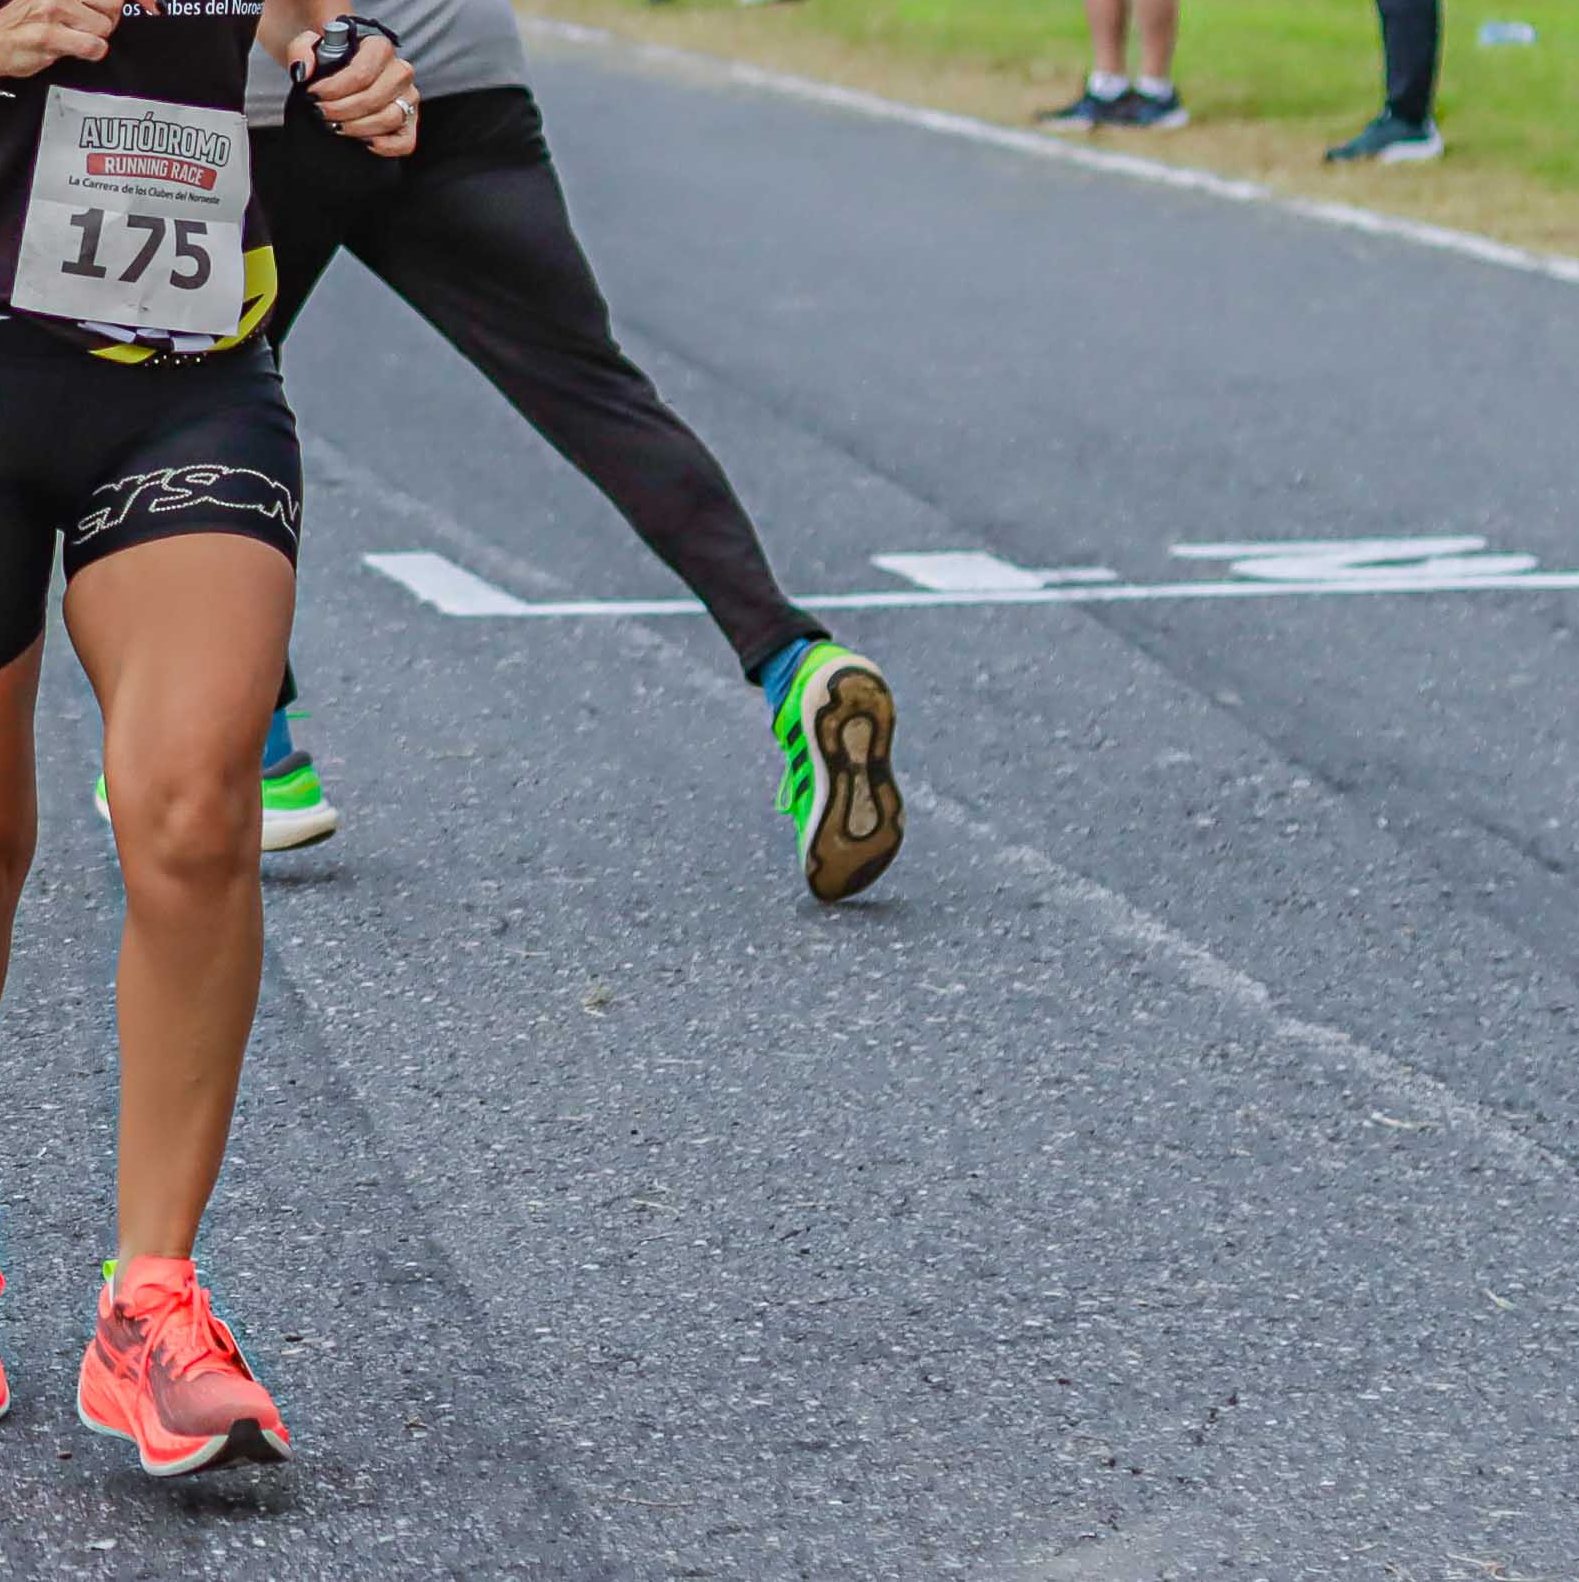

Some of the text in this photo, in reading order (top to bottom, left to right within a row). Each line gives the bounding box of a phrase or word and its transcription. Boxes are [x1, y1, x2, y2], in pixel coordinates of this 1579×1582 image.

[122, 3, 141, 16] os
[79, 111, 231, 167] AUTÓDROMO
[104, 156, 204, 186] RUNNING RACE
[69, 175, 80, 186] La
[82, 177, 119, 193] Carrera
[122, 183, 134, 194] de
[135, 184, 147, 196] los
[175, 190, 188, 201] del
[61, 207, 211, 290] 175
